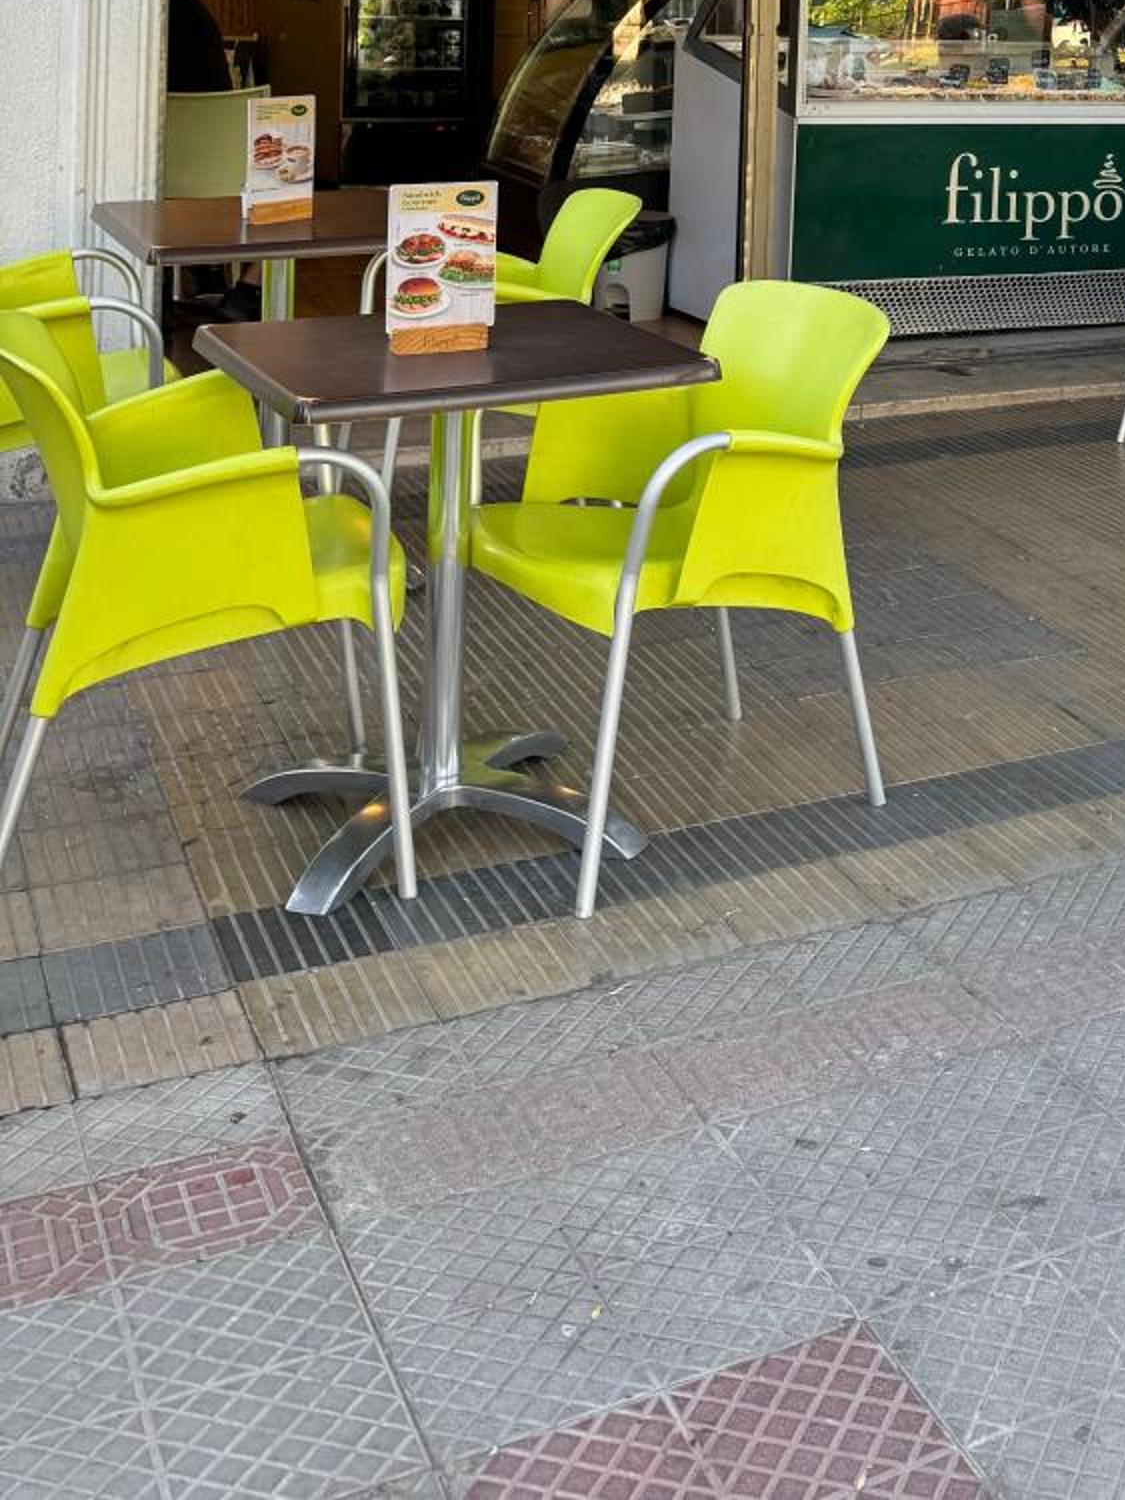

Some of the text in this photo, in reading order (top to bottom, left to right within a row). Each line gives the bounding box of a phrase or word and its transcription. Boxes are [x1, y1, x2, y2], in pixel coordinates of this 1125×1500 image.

[942, 152, 1124, 241] filippo
[954, 243, 1112, 258] GELATO D'AUTORE
